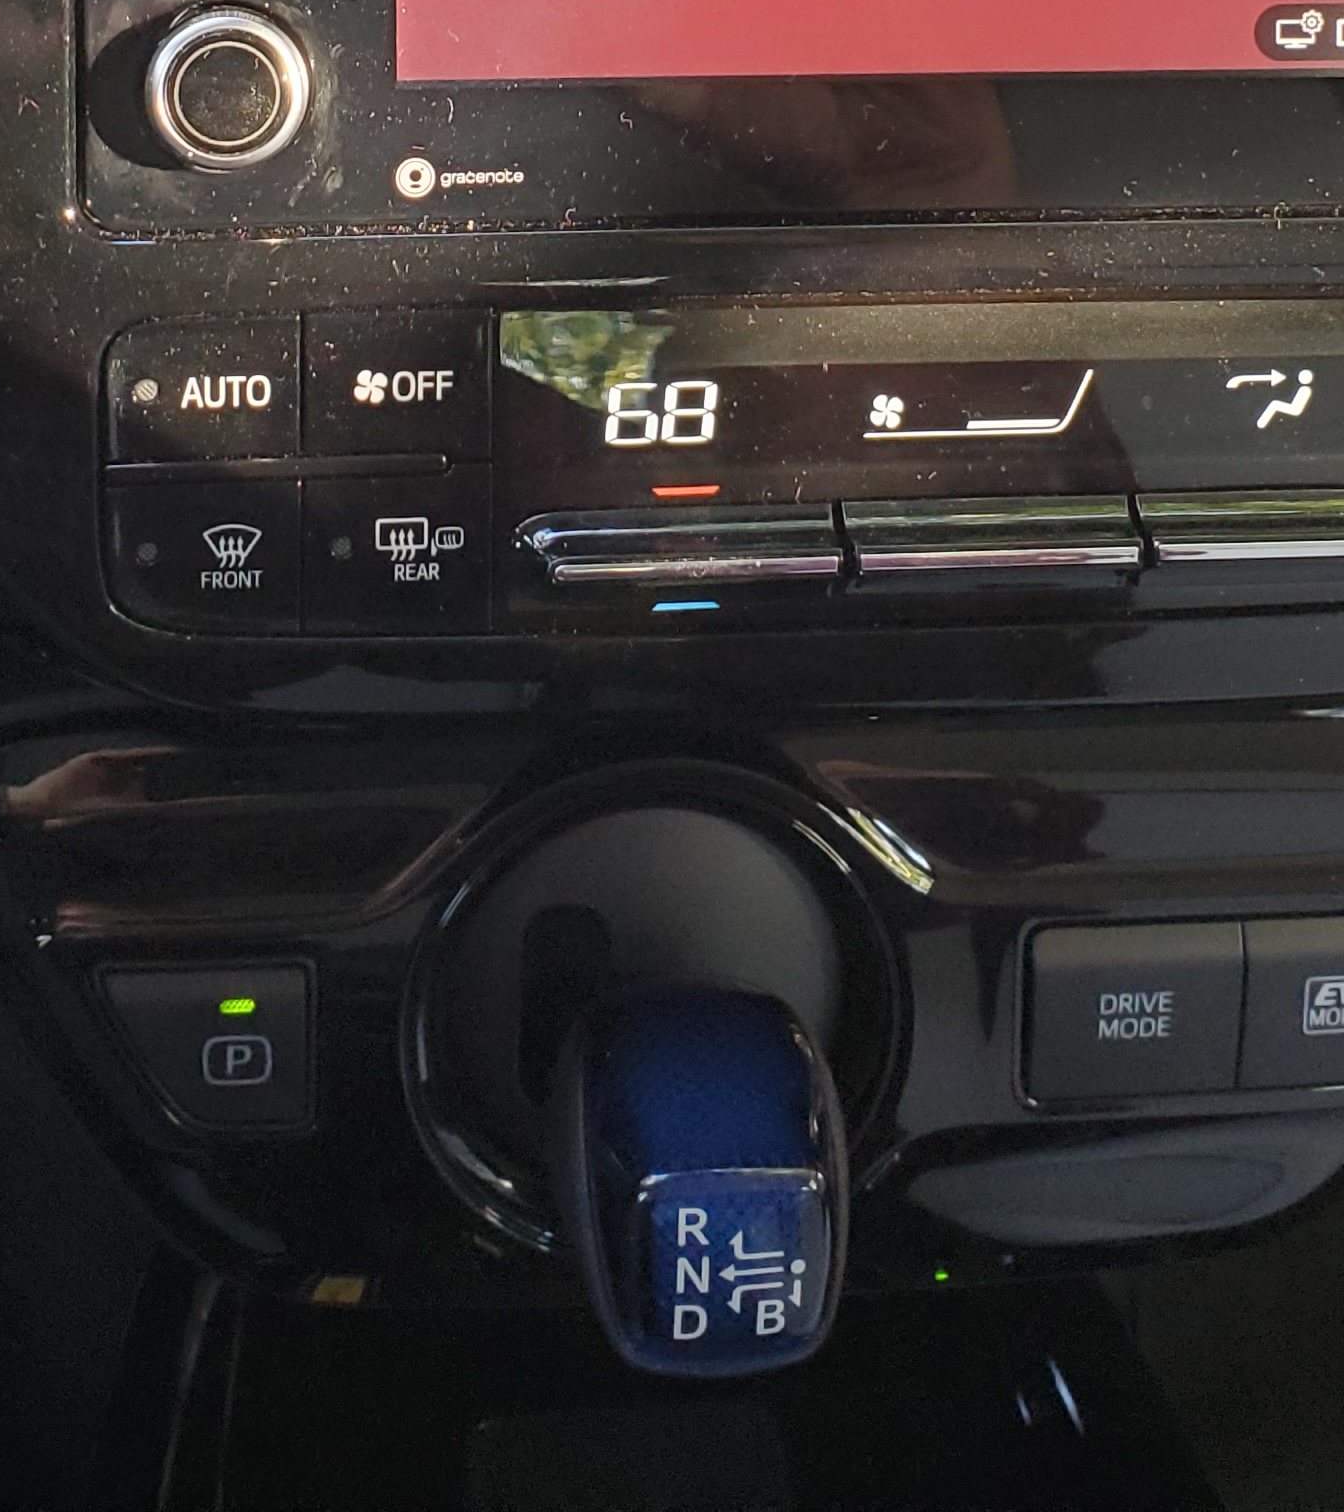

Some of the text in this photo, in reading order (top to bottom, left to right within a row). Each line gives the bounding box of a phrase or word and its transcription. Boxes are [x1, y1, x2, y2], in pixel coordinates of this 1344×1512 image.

[440, 169, 525, 188] gracenote
[180, 374, 271, 409] AUTO
[392, 370, 454, 401] OFF
[604, 380, 718, 447] 68
[200, 569, 264, 589] FRONT
[394, 563, 440, 582] REAR
[1100, 992, 1175, 1016] DRIVE
[1098, 1017, 1171, 1040] MODE
[226, 1044, 253, 1076] P
[677, 1208, 710, 1247] R
[676, 1255, 711, 1294] N
[673, 1304, 708, 1340] D
[756, 1299, 786, 1335] B
